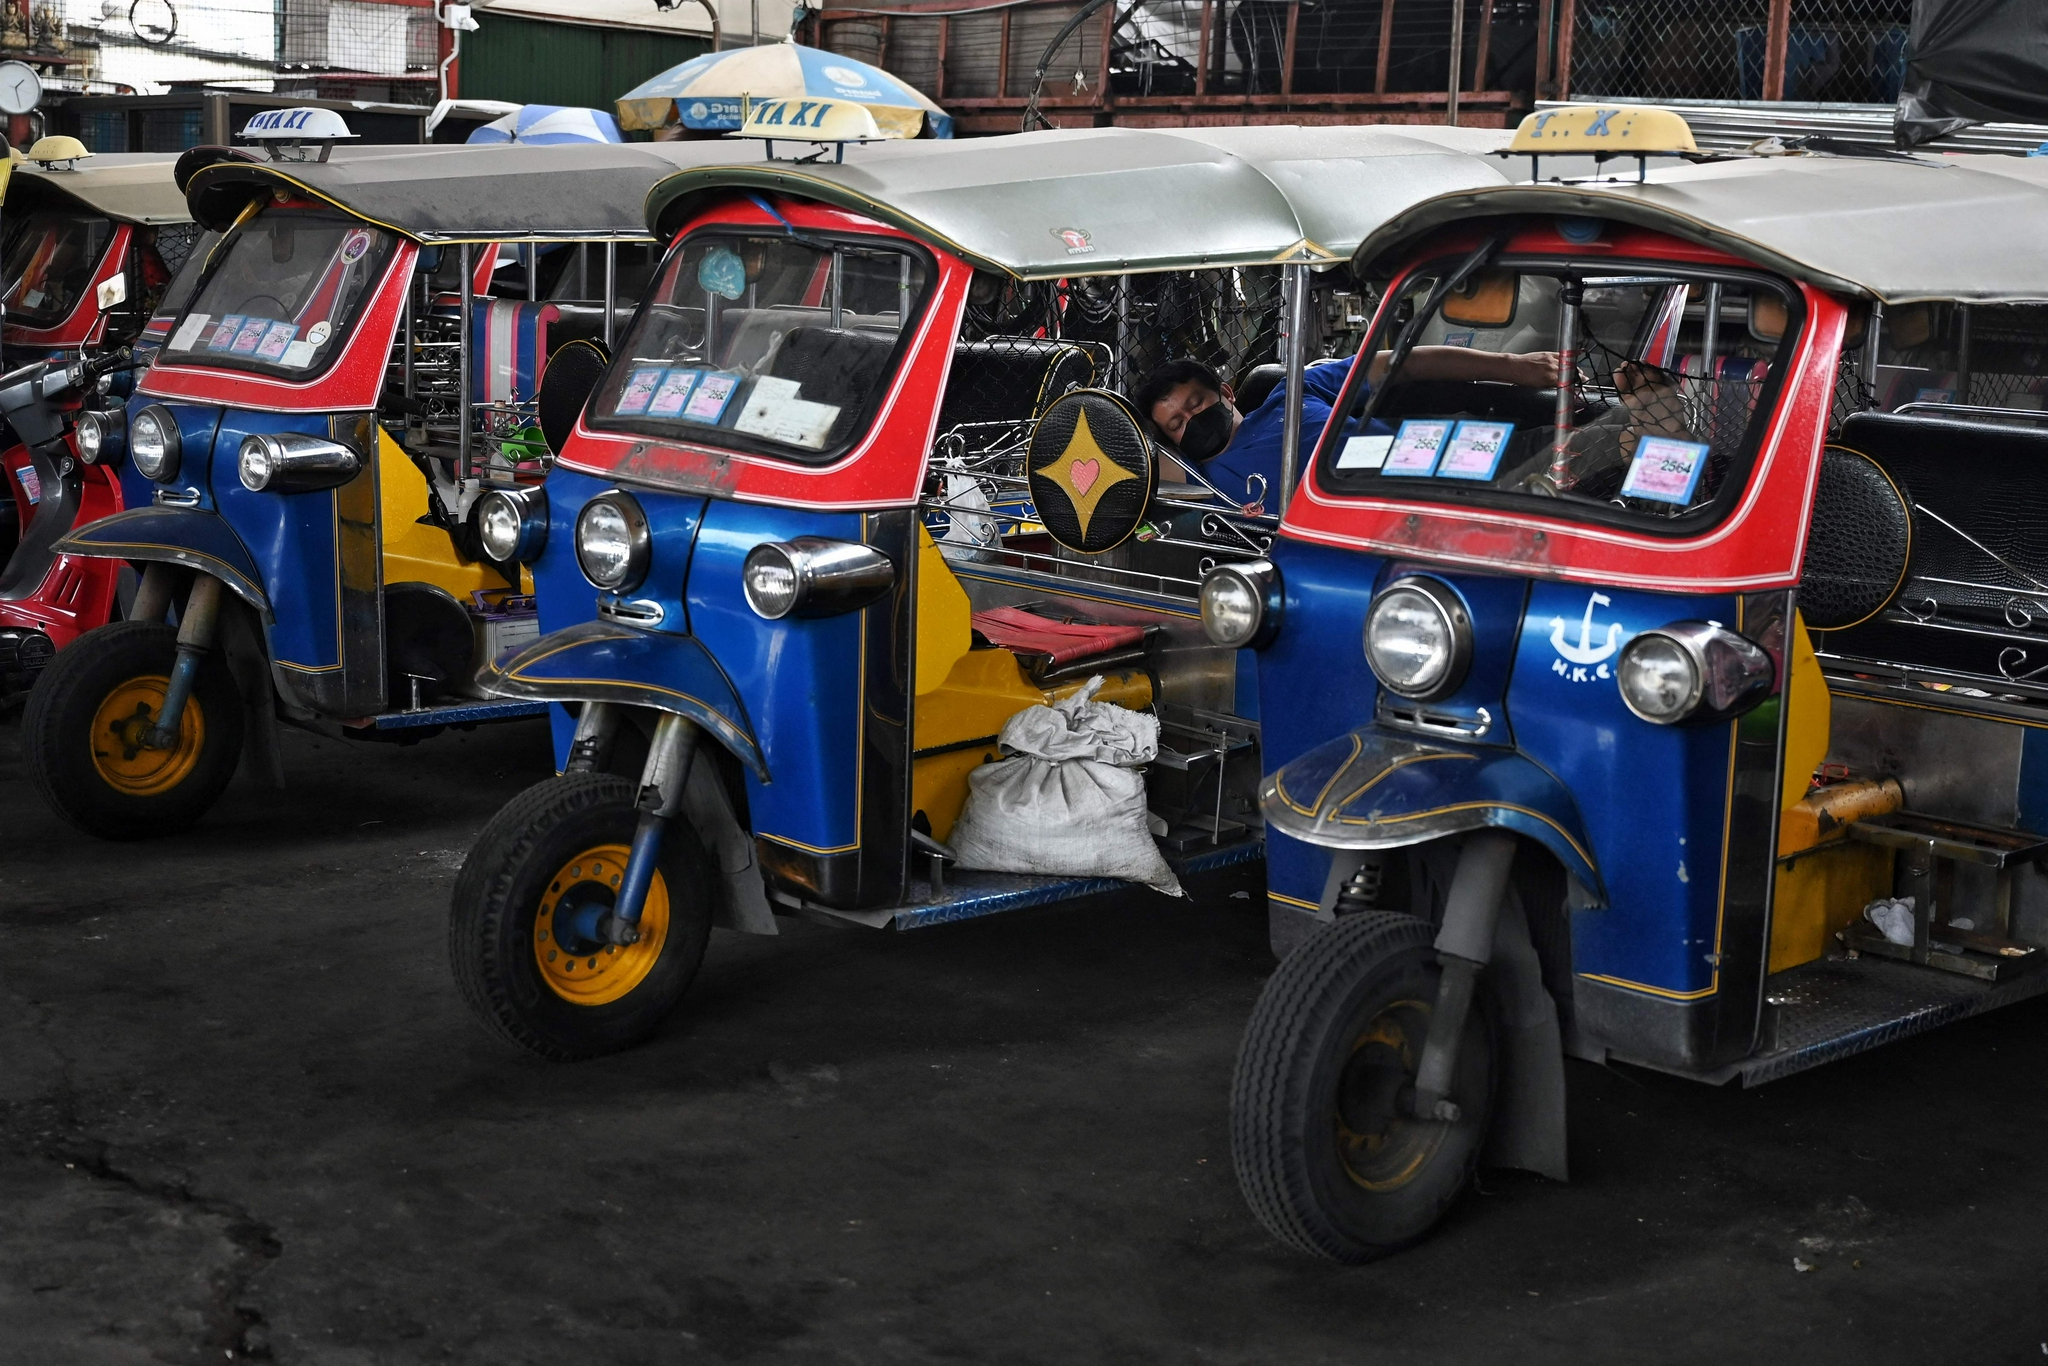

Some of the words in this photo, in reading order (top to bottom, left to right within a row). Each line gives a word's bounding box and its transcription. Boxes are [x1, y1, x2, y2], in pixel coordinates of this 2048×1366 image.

[262, 110, 314, 129] TAXI
[754, 101, 833, 127] TAXI
[1414, 438, 1439, 450] 2562
[1471, 440, 1498, 453] 2563
[1660, 459, 1692, 474] 2564
[22, 657, 47, 666] SUZU
